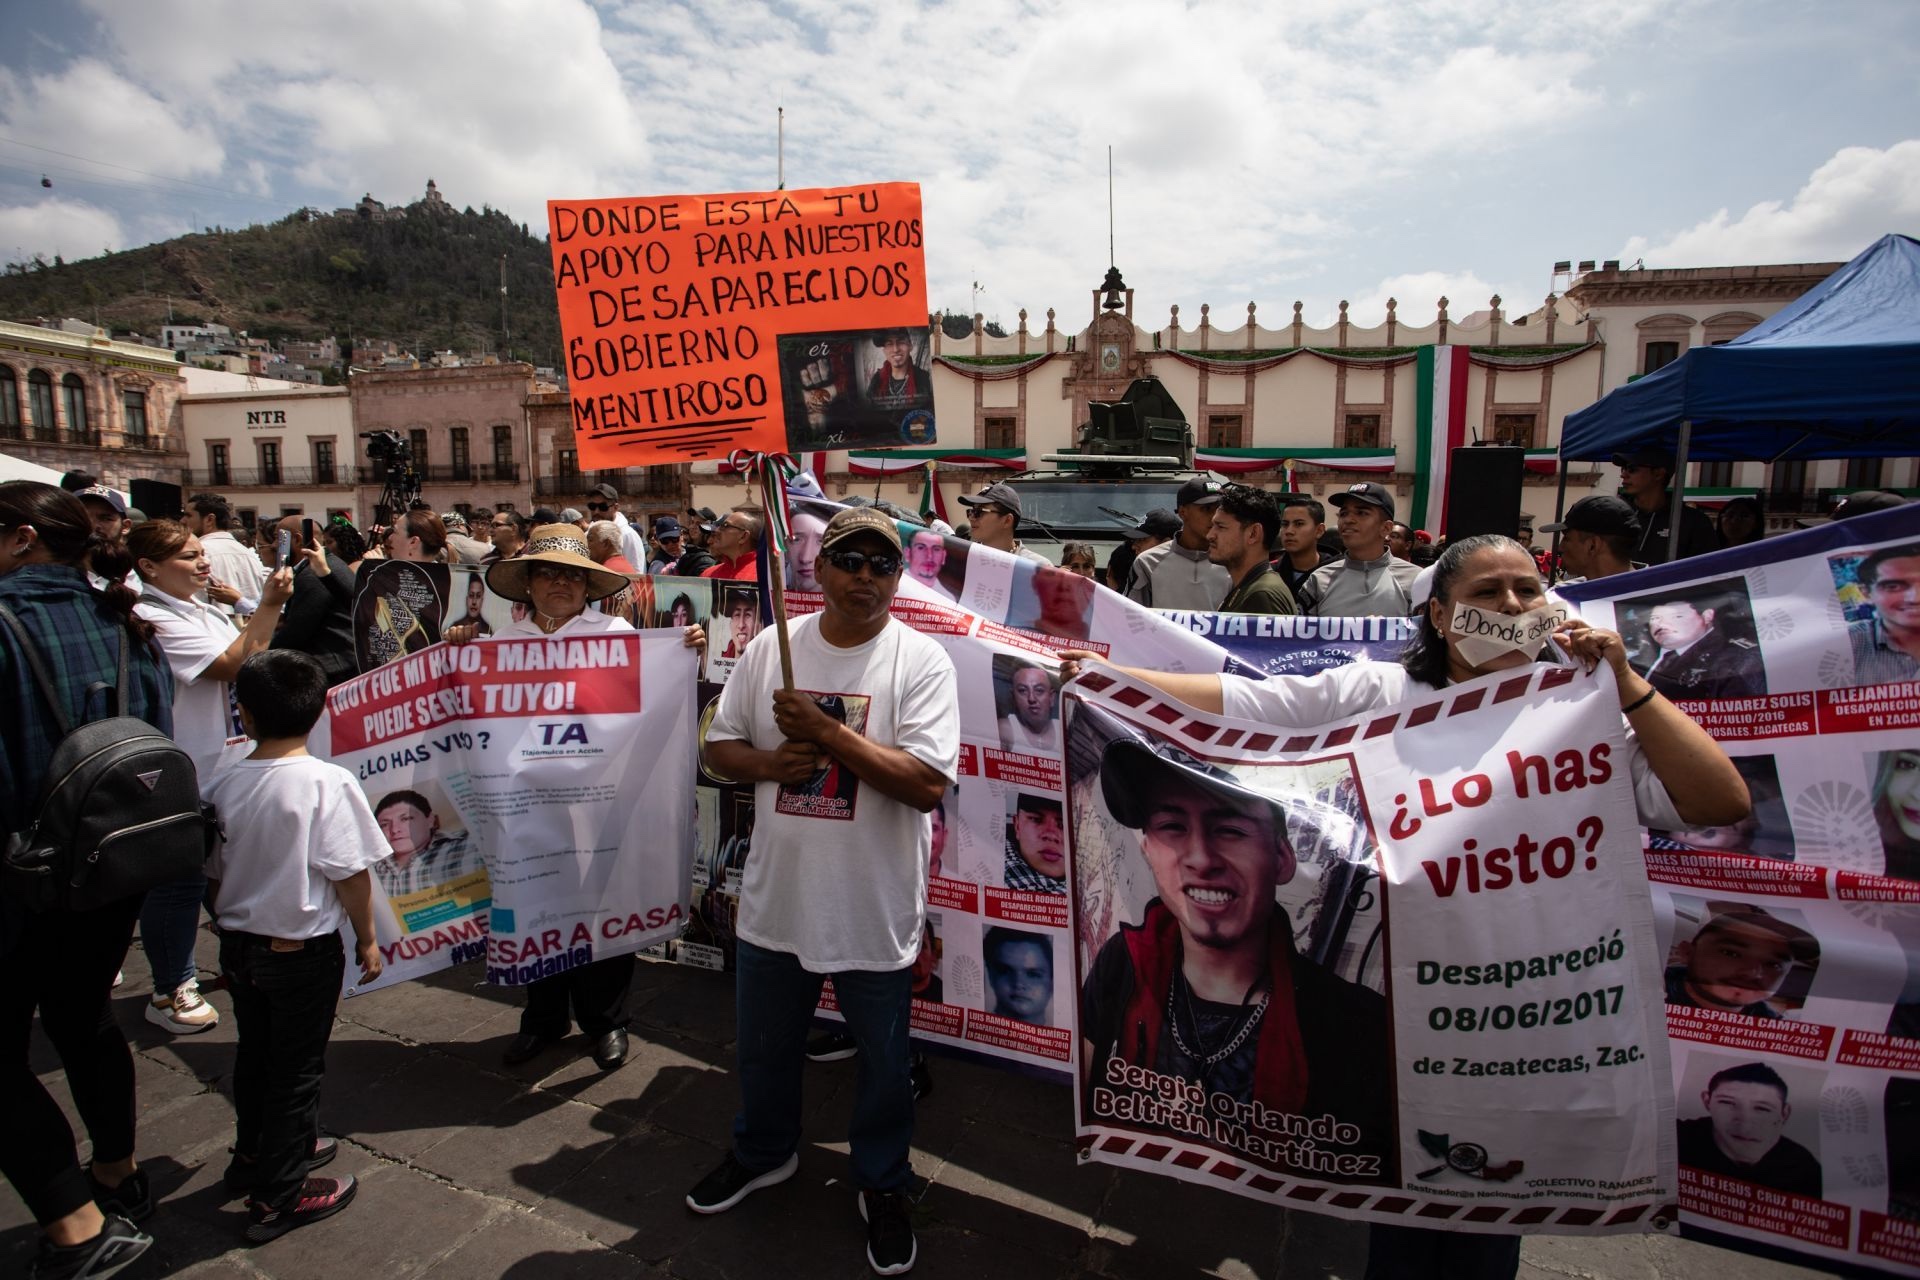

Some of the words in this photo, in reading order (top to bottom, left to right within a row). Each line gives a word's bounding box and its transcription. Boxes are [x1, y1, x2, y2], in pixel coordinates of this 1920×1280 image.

[555, 203, 680, 243] DONDE
[705, 196, 802, 227] ESTA
[824, 189, 879, 217] TU
[557, 241, 670, 288] APOYO
[694, 231, 778, 267] PARA
[784, 219, 922, 259] NUESTROS
[589, 262, 911, 328] DESAPARECIDOS
[569, 325, 759, 381] GOBIERNO
[573, 373, 767, 432] MENTIROSO
[247, 411, 286, 424] NTR
[895, 599, 924, 610] DELGADO
[1005, 626, 1047, 641] GUADALUPE
[1049, 635, 1068, 646] CRUZ
[1069, 639, 1108, 653] GUERRERO
[371, 665, 402, 700] FUE
[403, 656, 426, 688] MI
[363, 701, 414, 743] PUEDE
[482, 681, 576, 714] TUYO!
[1711, 697, 1767, 713] ÁLVAREZ
[1770, 692, 1811, 709] SOLÍS
[1705, 711, 1785, 725] 14/JULIO/2016
[1754, 721, 1809, 736] ZACATECAS
[1869, 716, 1884, 727] EN
[537, 723, 589, 745] TA
[359, 756, 387, 780] ¿LO
[391, 745, 431, 769] HAS
[985, 748, 1004, 761] JUAN
[1004, 751, 1036, 767] MANUEL
[1038, 758, 1062, 771] SAUC
[997, 763, 1040, 777] DESAPARECIDO
[1000, 772, 1007, 780] EN
[809, 796, 847, 807] Orlando
[1389, 772, 1491, 841] ¿Lo
[1506, 742, 1613, 799] has
[808, 805, 851, 817] Martínez
[1422, 815, 1605, 898] visto?
[1680, 854, 1755, 870] RODRÍGUEZ
[1646, 864, 1700, 876] APARECIDO
[1705, 869, 1722, 878] 22/
[1724, 870, 1786, 882] DICIEMBRE/
[1788, 872, 1818, 883] 2022
[951, 883, 977, 894] PERALES
[986, 889, 1011, 900] MIGUEL
[1681, 877, 1692, 886] DE
[1747, 882, 1777, 893] NUEVO
[1840, 889, 1855, 900] EN
[1856, 889, 1895, 900] NUEVO
[1001, 901, 1047, 913] DESAPARECIDO
[1010, 911, 1025, 920] JUAN
[361, 914, 489, 973] YÚDAME
[570, 922, 593, 946] A
[601, 903, 683, 940] CASA
[1416, 930, 1625, 987] Desapareció
[1428, 985, 1625, 1033] 08/06/2017
[969, 1012, 985, 1022] LUIS
[986, 1013, 1011, 1027] RAMÓN
[1011, 1019, 1036, 1034] ENCISO
[969, 1021, 1009, 1037] DESAPARECIDO
[1693, 1007, 1755, 1027] ESPARZA
[1757, 1017, 1821, 1036] CAMPOS
[1668, 1026, 1712, 1040] DURANGO
[1770, 1041, 1825, 1059] ZACATECAS
[1705, 1022, 1823, 1048] 29/SEPTIEMBRE/2022
[1849, 1030, 1889, 1043] JUAN
[1412, 1055, 1446, 1076] de
[1450, 1053, 1591, 1079] Zacatecas,
[1596, 1043, 1645, 1070] Zac.
[1840, 1053, 1854, 1062] EN
[1856, 1056, 1886, 1067] JEREZ
[1887, 1059, 1901, 1068] DE
[1106, 1056, 1205, 1107] Sergio
[1210, 1090, 1361, 1146] Orlando
[1093, 1087, 1211, 1140] Beltrán
[1216, 1119, 1381, 1177] Martínez
[1477, 1190, 1531, 1200] Nacionales
[1532, 1190, 1544, 1198] de
[1547, 1189, 1594, 1199] Personas
[1597, 1187, 1667, 1200] Desaparecidas
[1702, 1174, 1716, 1188] DE
[1757, 1189, 1787, 1207] CRUZ
[1792, 1198, 1846, 1221] DELGADO
[1711, 1204, 1744, 1223] VICTOR
[1791, 1223, 1844, 1247] ZACATECAS
[1749, 1200, 1830, 1230] 21/JULIO/2016
